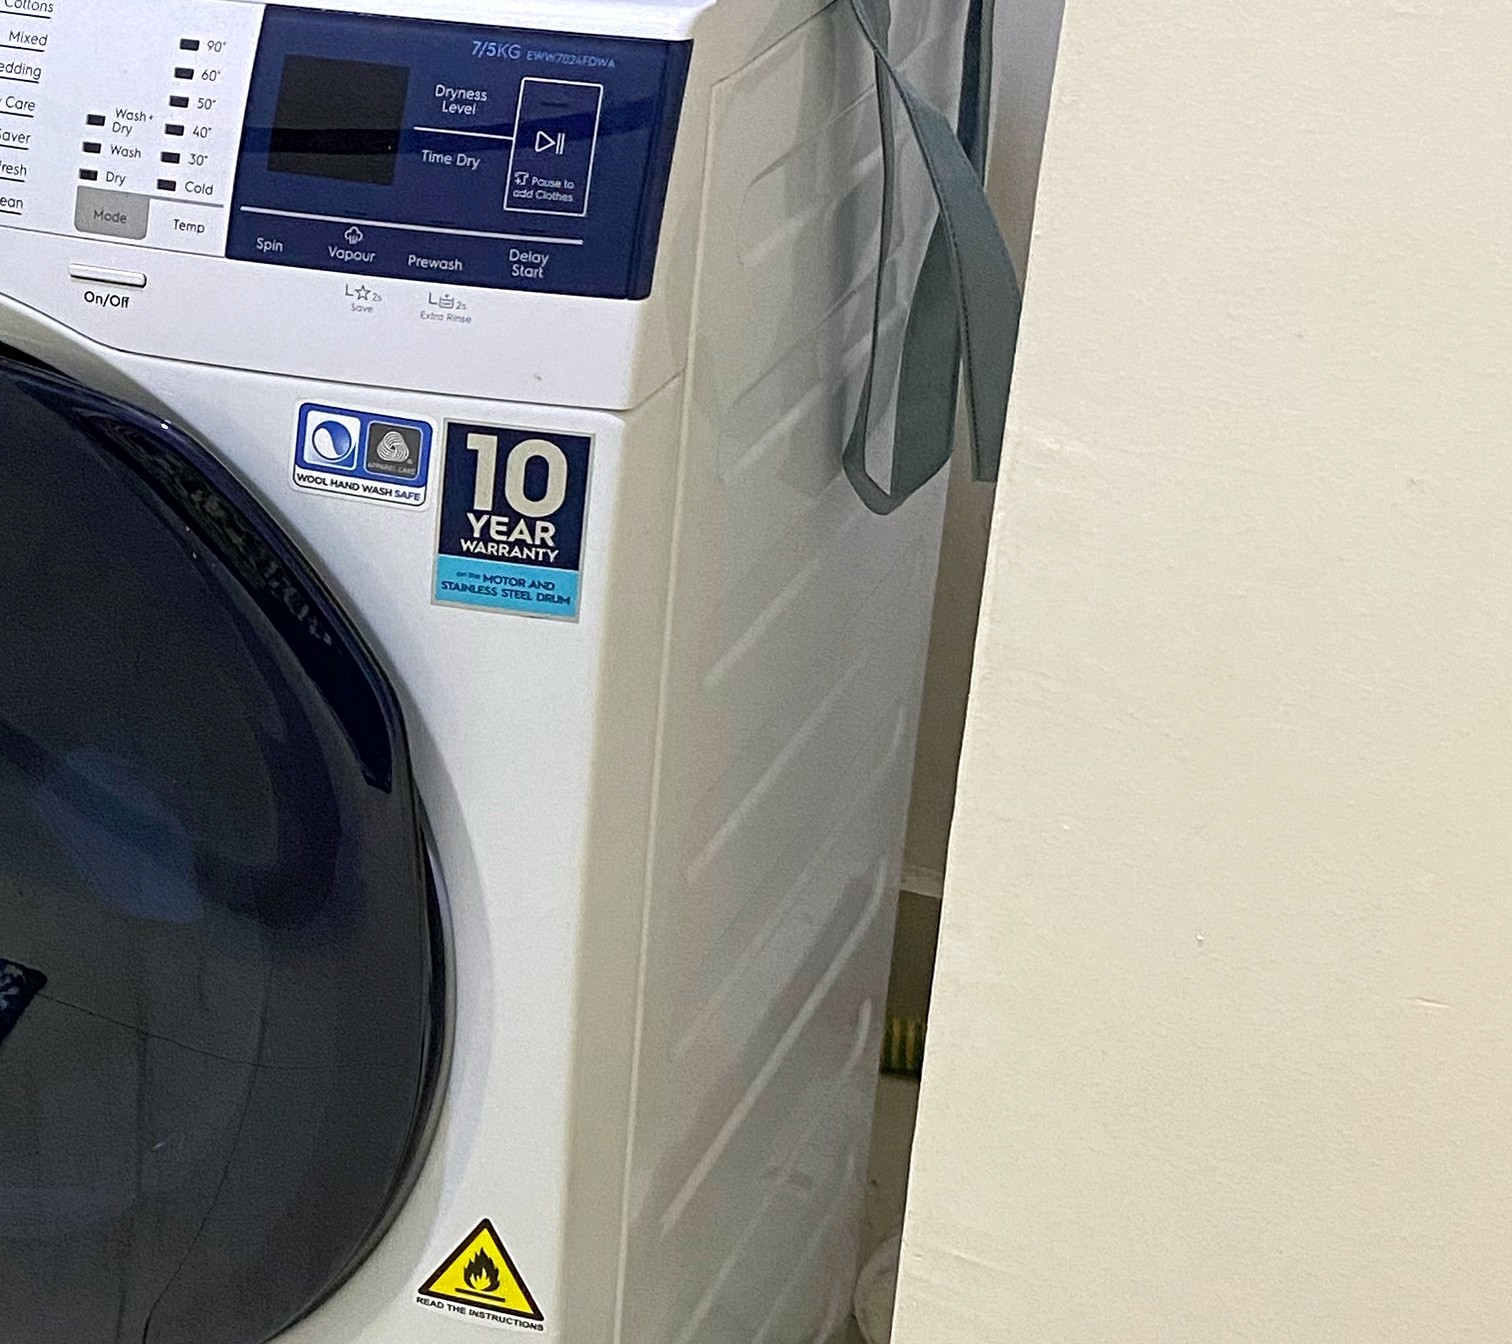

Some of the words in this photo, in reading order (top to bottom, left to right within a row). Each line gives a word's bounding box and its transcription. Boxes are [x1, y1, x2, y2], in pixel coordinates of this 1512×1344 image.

[8, 30, 48, 47] Mixed
[471, 40, 522, 60] 7/5KG
[435, 84, 488, 102] Dryness
[5, 95, 36, 111] Care
[441, 100, 477, 115] Level
[112, 122, 133, 137] Dry
[110, 144, 141, 159] Wash
[422, 150, 452, 165] Time
[456, 154, 480, 170] Dry
[106, 171, 127, 186] Dry
[531, 176, 561, 188] Pause
[563, 179, 575, 190] to
[185, 181, 213, 196] Cold
[512, 189, 533, 199] add
[535, 190, 574, 202] Clothes
[93, 209, 127, 224] Mode
[173, 219, 205, 234] Temp
[256, 237, 284, 253] Spin
[328, 246, 376, 263] Vapour
[408, 254, 463, 271] Prewash
[509, 248, 549, 267] Delay
[511, 264, 544, 279] Start
[84, 291, 130, 308] On/Off
[350, 303, 374, 314] Save
[420, 311, 444, 322] Extra
[446, 313, 472, 324] Rinse
[466, 432, 568, 518] 10
[296, 473, 328, 486] WOOL
[330, 479, 360, 492] HAND
[361, 484, 393, 497] WASH
[394, 489, 421, 501] SAFE
[466, 512, 558, 548] YEAR
[460, 538, 559, 564] WARRANTY
[482, 574, 526, 588] MOTOR
[529, 580, 556, 591] AND
[441, 580, 498, 596] STAINLESS
[501, 588, 533, 601] STEEL
[536, 592, 571, 605] DRUM
[416, 1296, 445, 1309] READ
[447, 1303, 466, 1315] THE
[468, 1309, 544, 1332] INSTRUCTIONS
